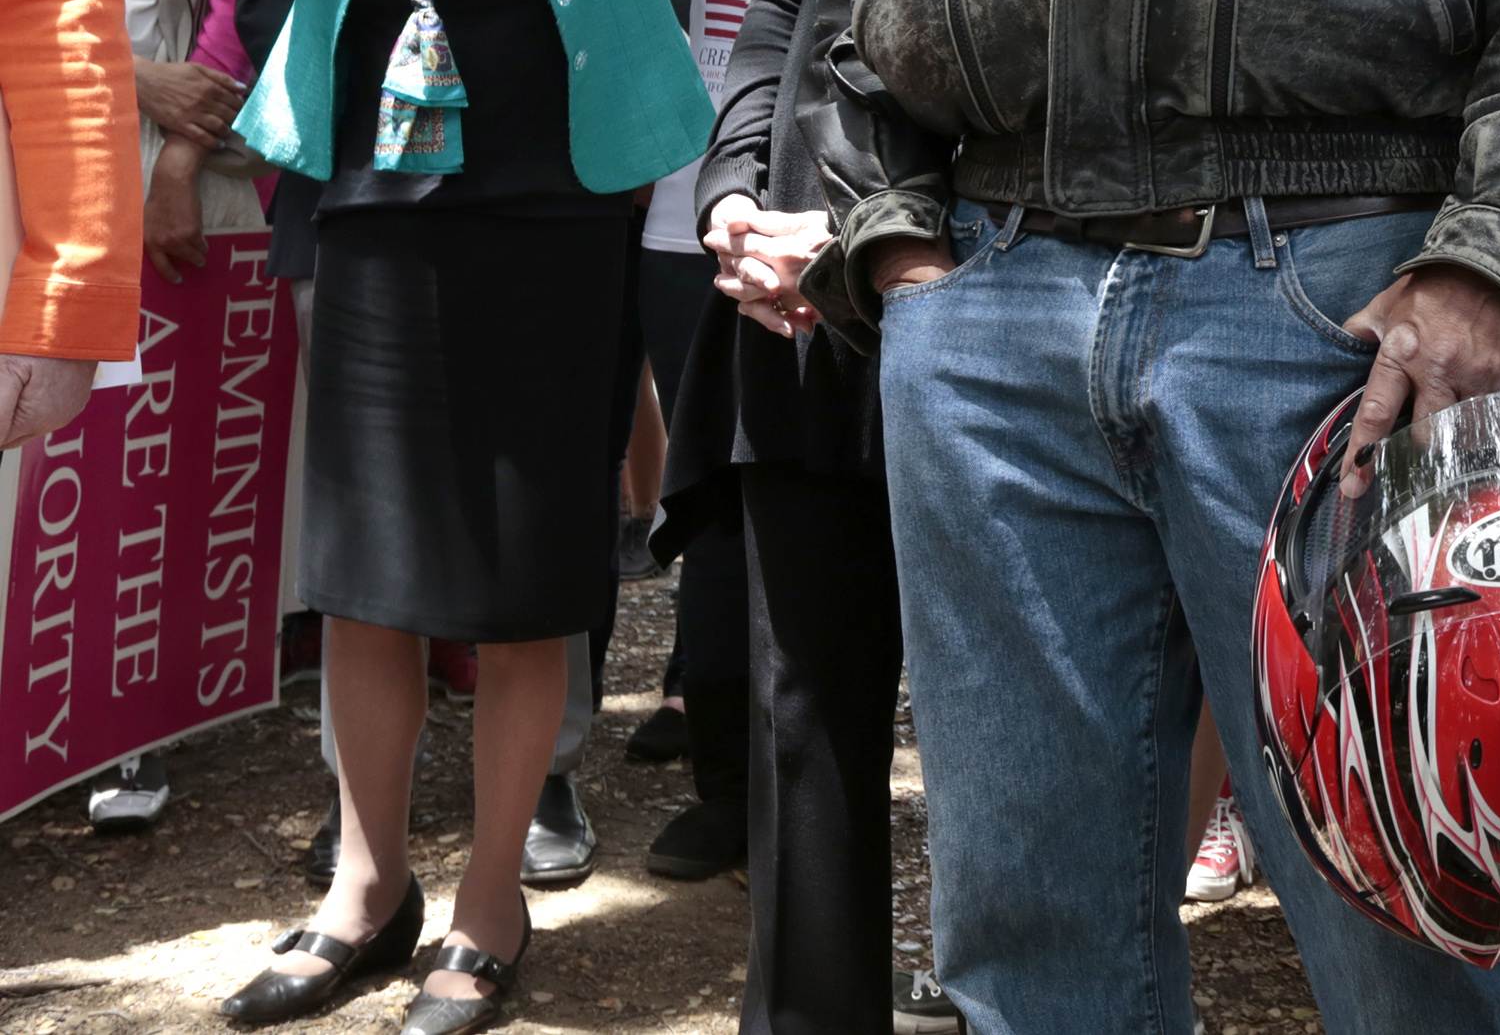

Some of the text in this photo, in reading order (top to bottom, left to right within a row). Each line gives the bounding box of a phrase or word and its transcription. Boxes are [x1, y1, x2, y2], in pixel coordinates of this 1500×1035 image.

[111, 307, 180, 698] ARE THE
[198, 244, 278, 707] FEMINISTS
